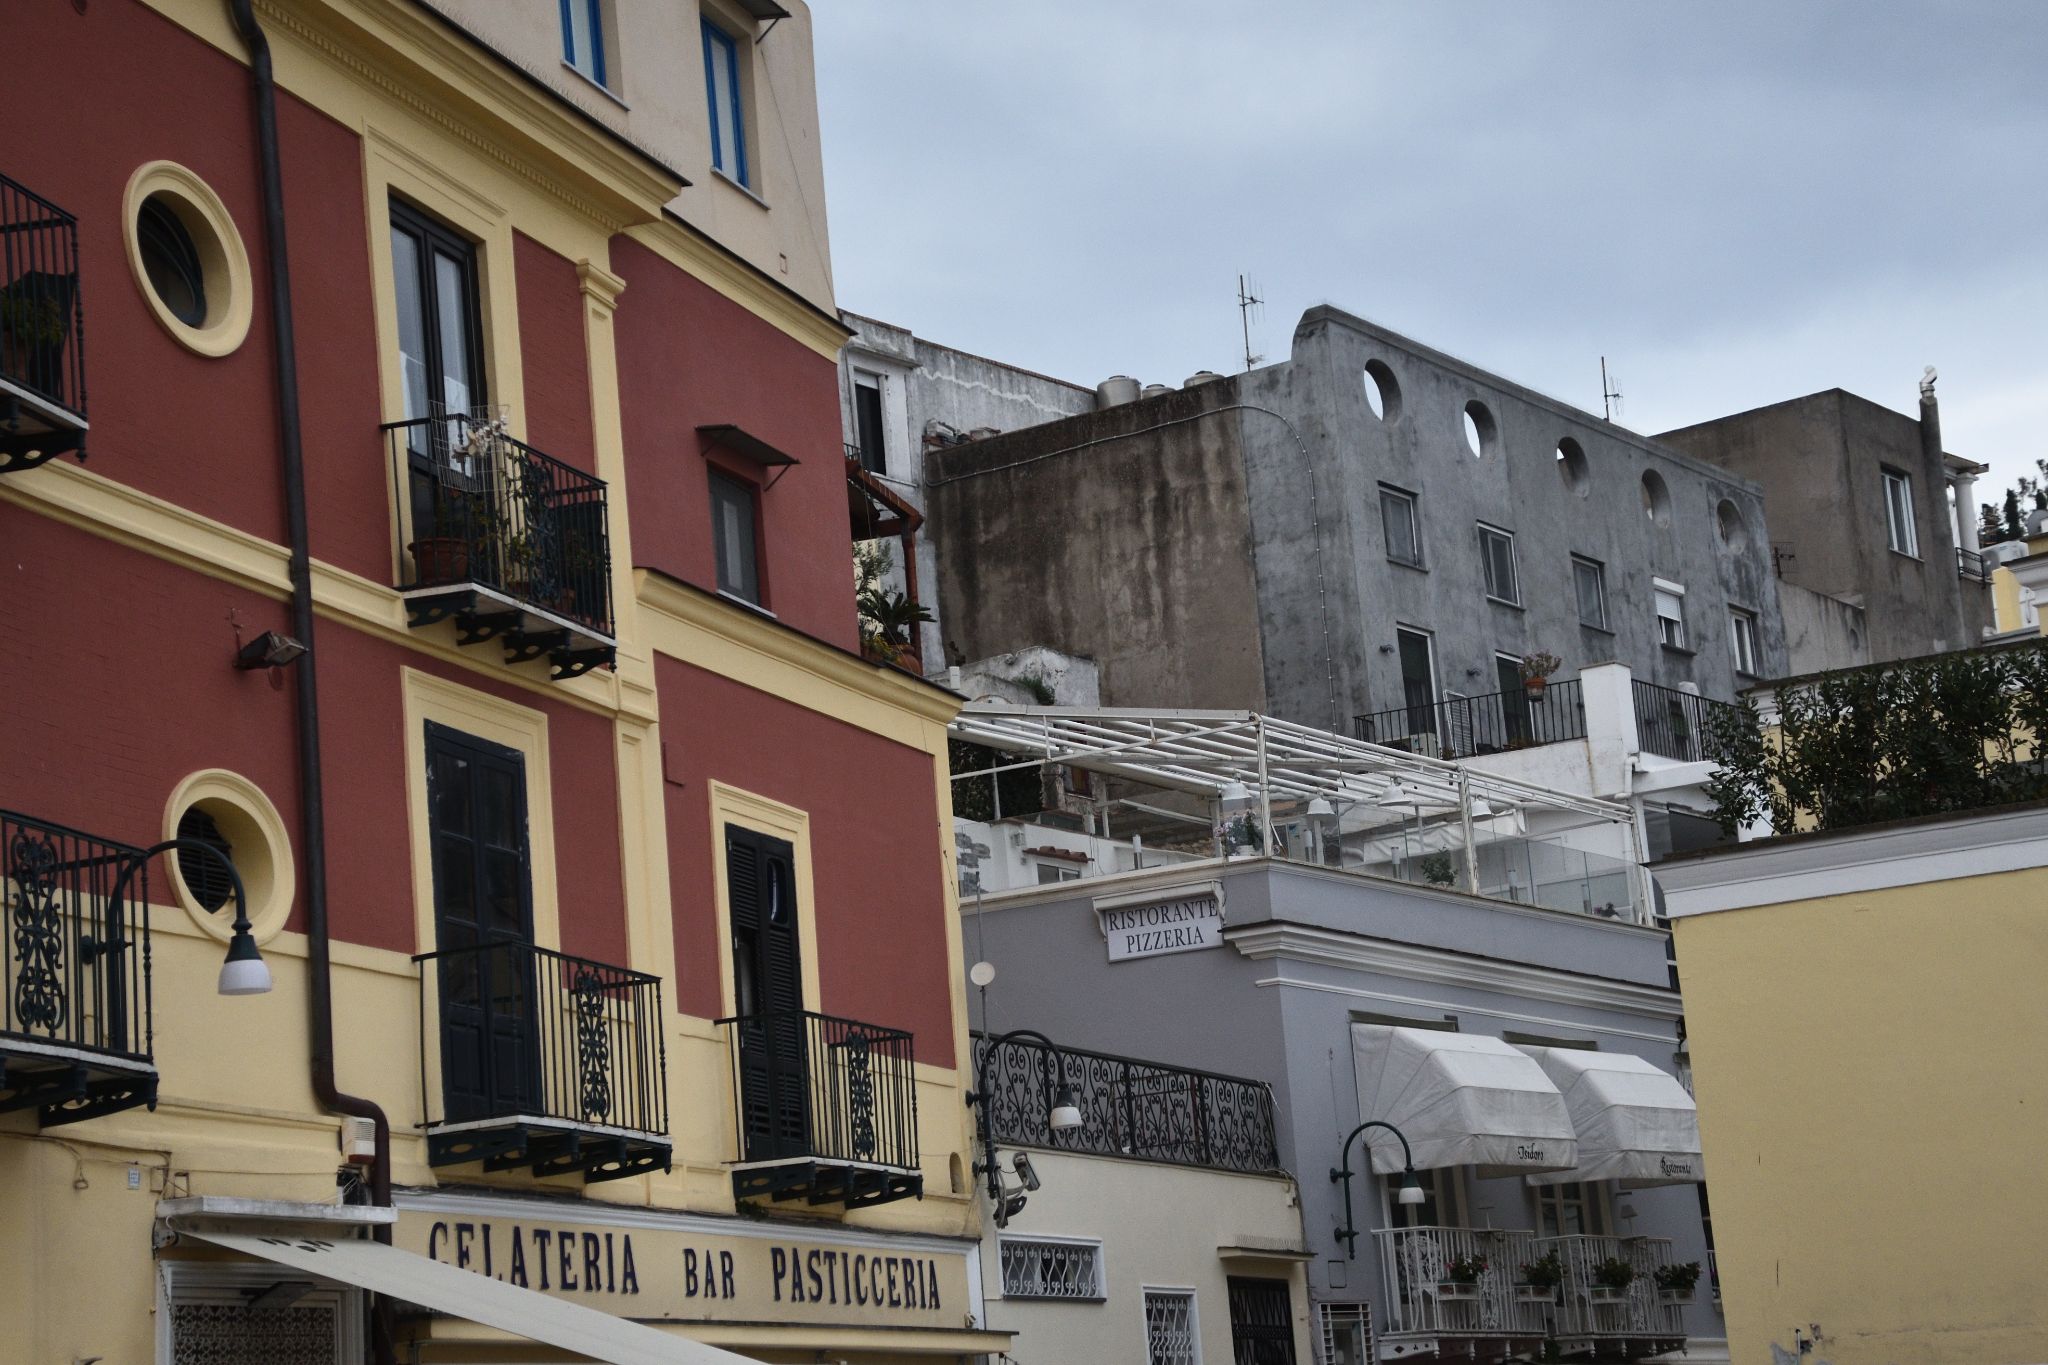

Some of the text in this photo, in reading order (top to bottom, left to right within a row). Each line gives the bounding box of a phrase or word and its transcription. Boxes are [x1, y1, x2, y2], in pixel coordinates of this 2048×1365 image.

[1109, 900, 1218, 931] RISTORANTE
[1126, 926, 1204, 953] PIZZERIA
[683, 1248, 736, 1299] BAR
[770, 1247, 941, 1310] PASTICCERIA
